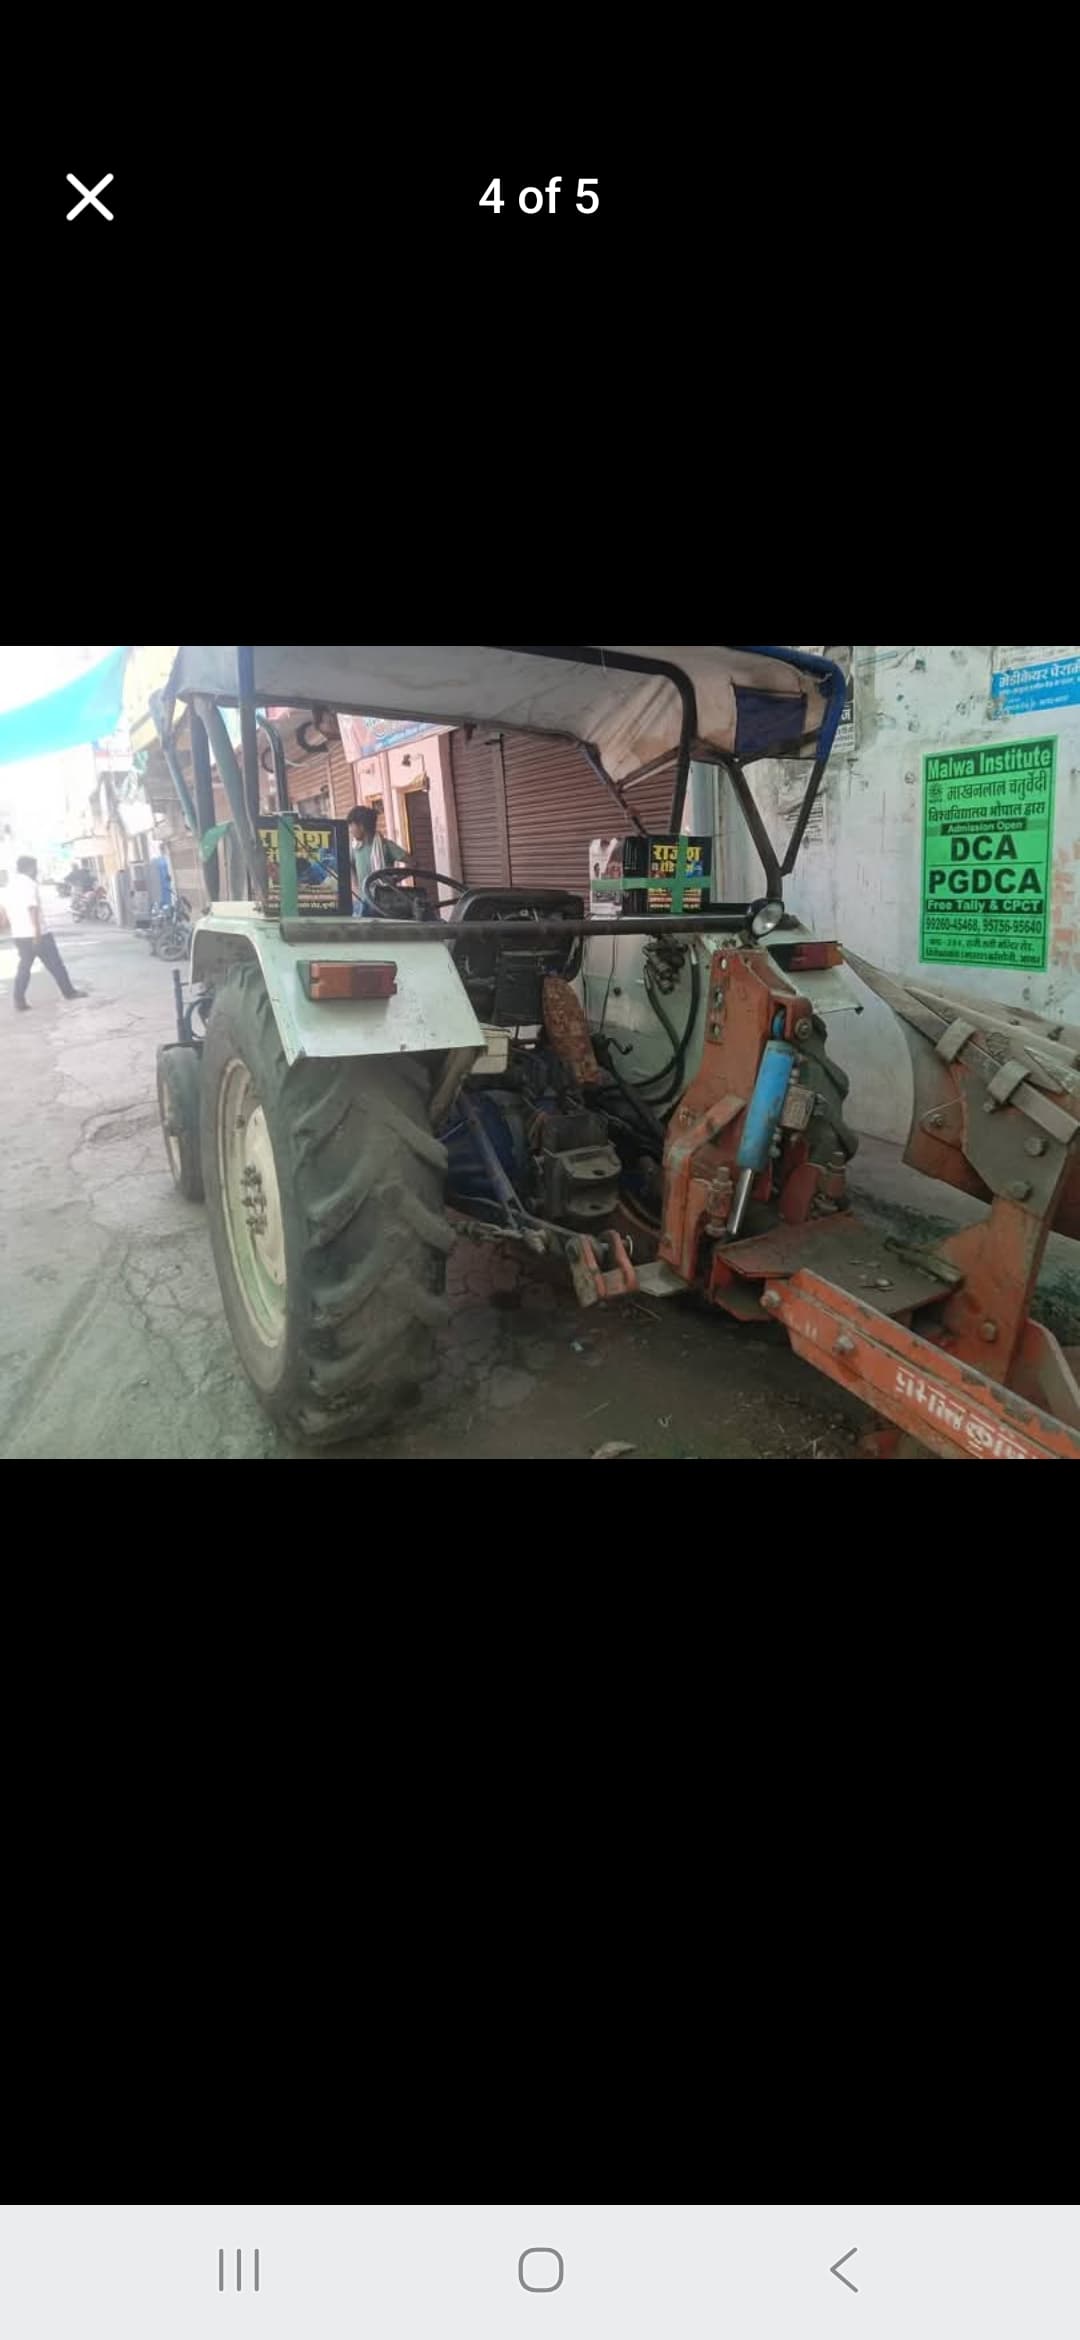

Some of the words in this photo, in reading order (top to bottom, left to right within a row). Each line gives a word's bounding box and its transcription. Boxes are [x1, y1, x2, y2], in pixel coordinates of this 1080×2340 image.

[928, 757, 974, 780] Malwa
[979, 746, 1051, 773] Institute
[990, 801, 1021, 817] भोपाल
[948, 822, 995, 833] Admission
[996, 820, 1024, 832] Open
[951, 834, 1018, 861] DCA
[929, 867, 1042, 895] PGDCA
[927, 900, 953, 910] Free
[957, 900, 985, 912] Tally
[989, 900, 999, 911] &
[1003, 900, 1040, 911] CPCT
